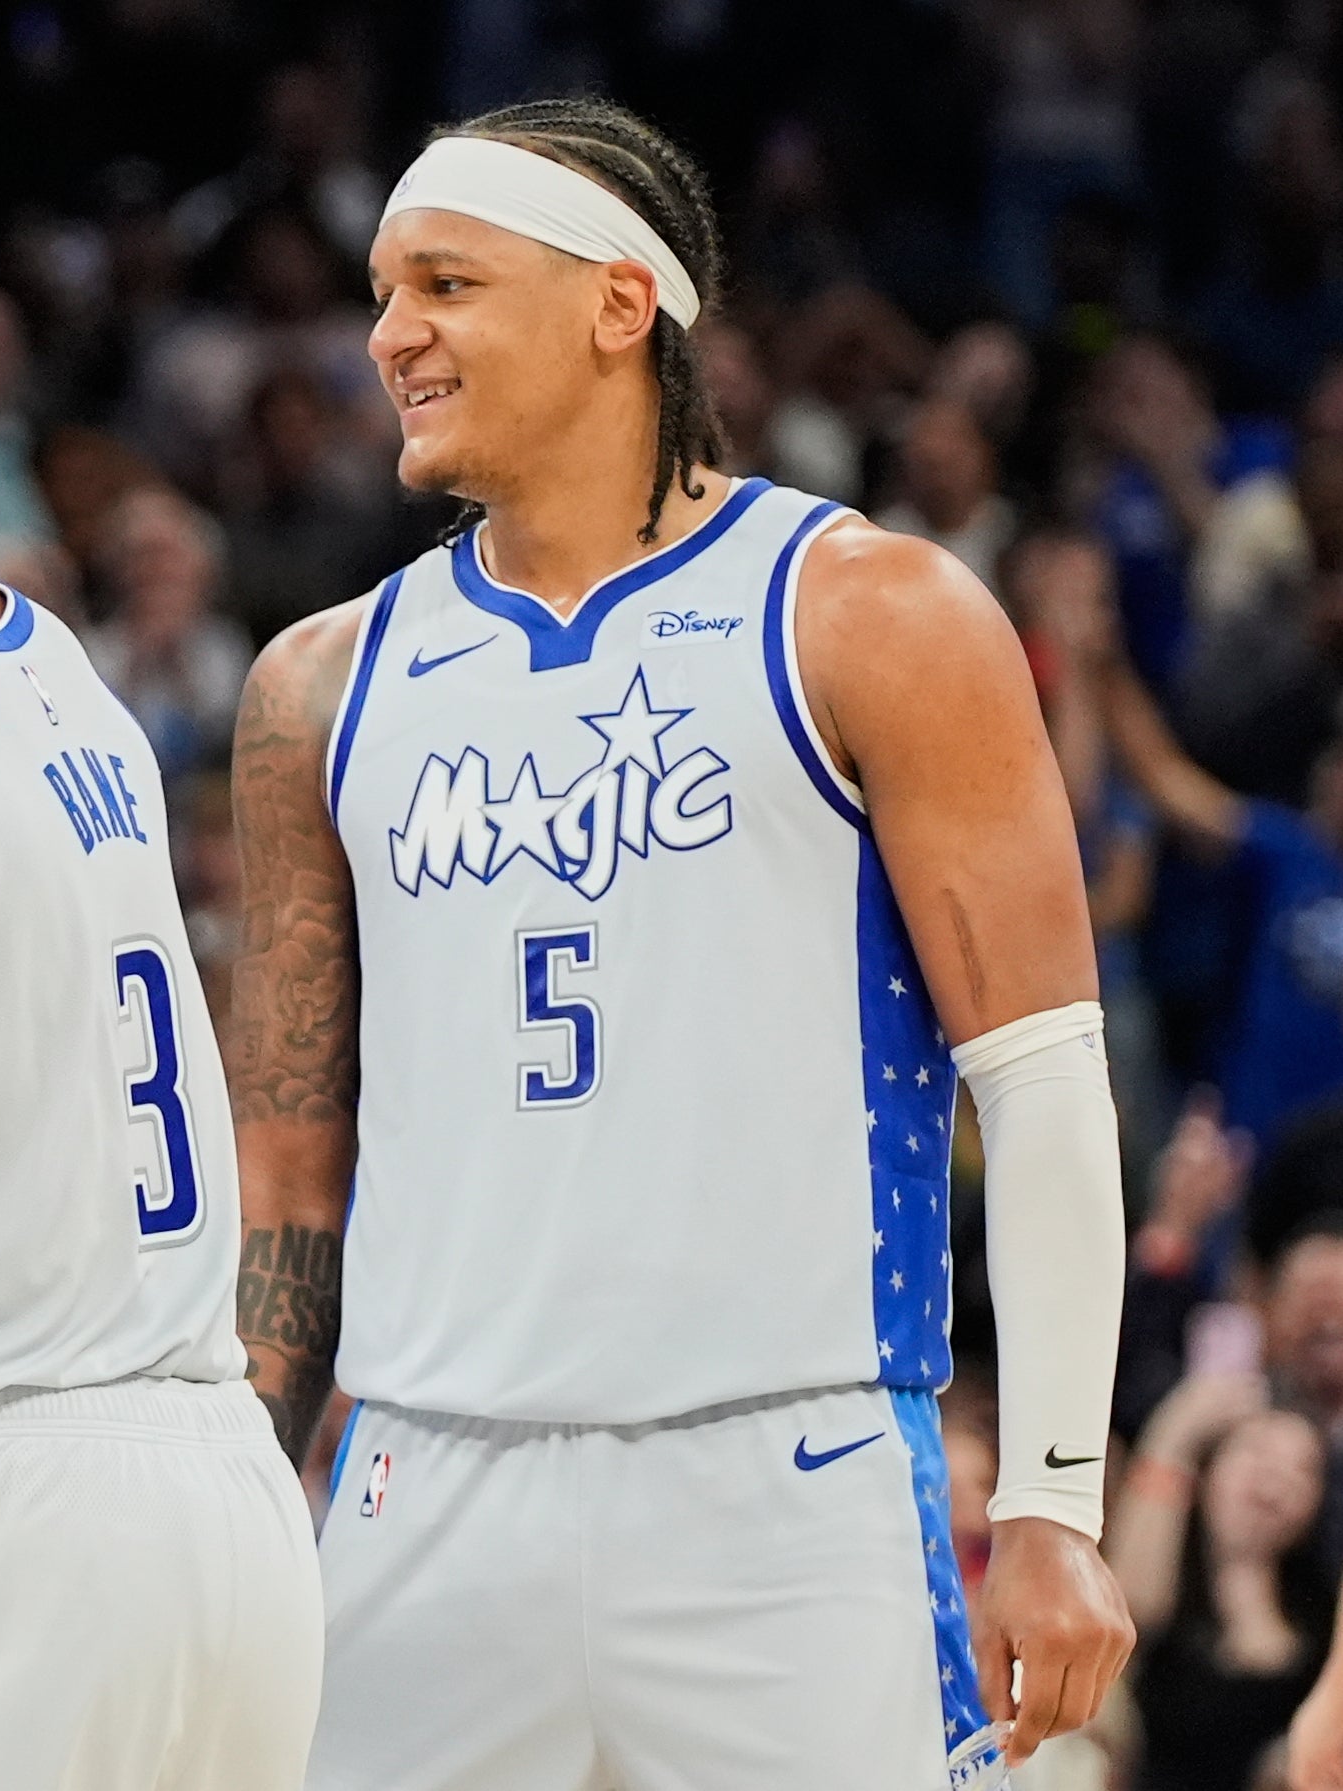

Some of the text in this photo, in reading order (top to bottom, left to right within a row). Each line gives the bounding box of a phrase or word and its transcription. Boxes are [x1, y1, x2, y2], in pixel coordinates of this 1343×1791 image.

[647, 610, 744, 639] Disney
[43, 747, 147, 855] BANE
[390, 664, 732, 901] Magic
[112, 933, 207, 1253] 3
[515, 921, 603, 1112] 5
